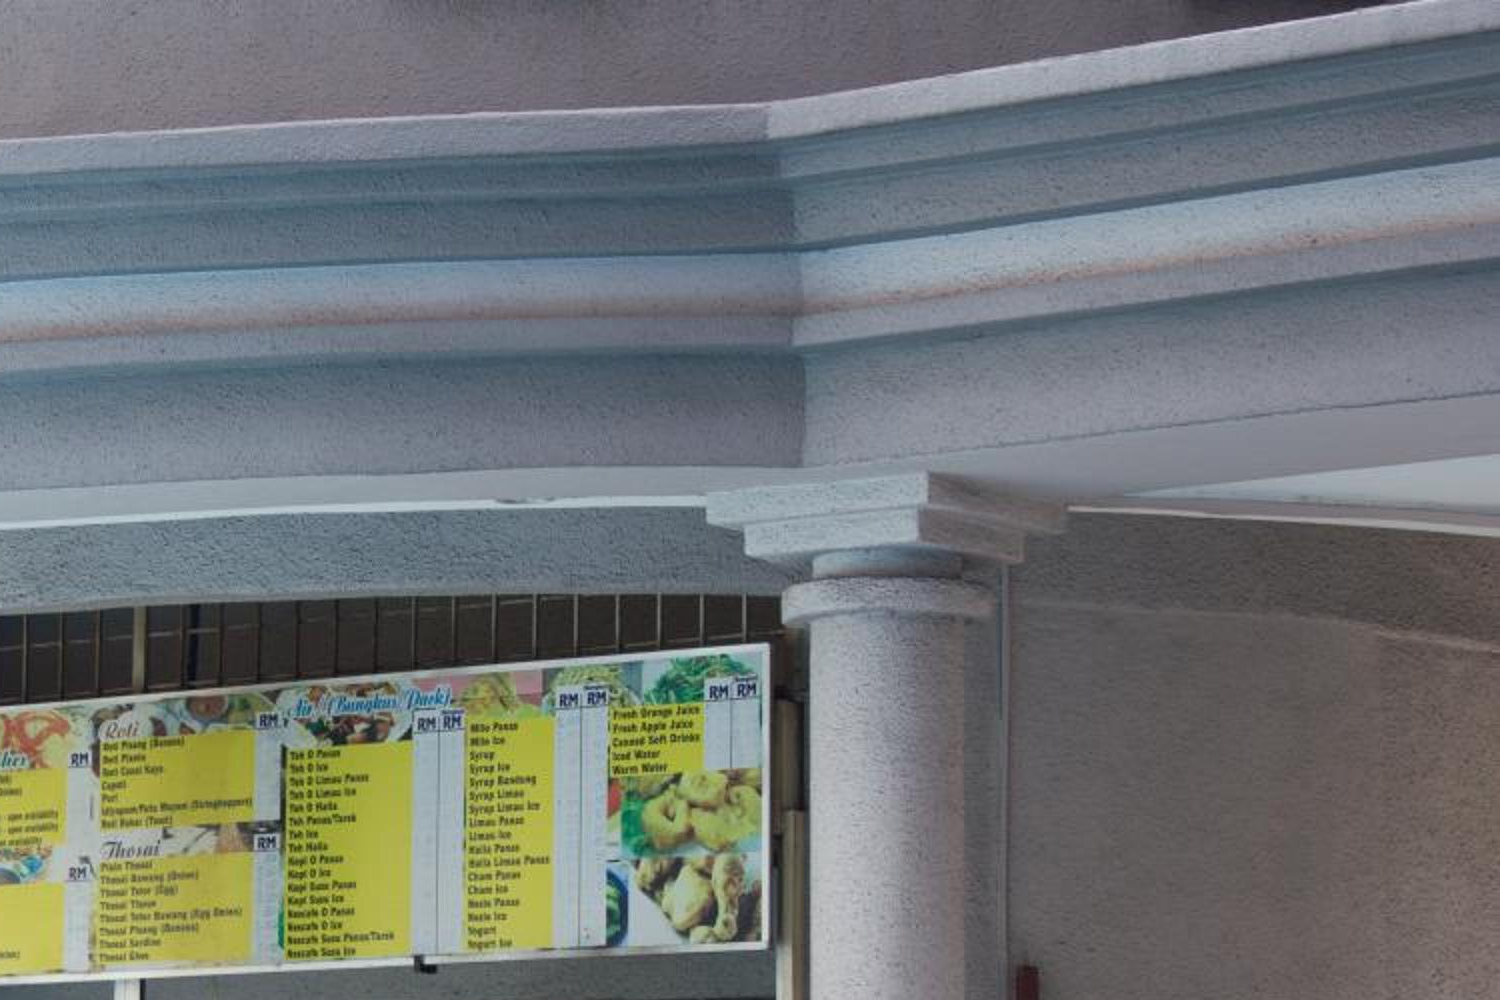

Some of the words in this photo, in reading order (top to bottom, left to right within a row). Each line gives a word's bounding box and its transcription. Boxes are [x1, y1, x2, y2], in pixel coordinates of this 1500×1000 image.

[710, 685, 728, 698] RM
[738, 682, 756, 696] RM
[560, 693, 578, 706] RM
[587, 691, 606, 704] RM
[613, 709, 637, 719] Fresh
[640, 707, 672, 718] Orange
[676, 705, 700, 715] Juice
[259, 714, 278, 727] RM
[418, 717, 436, 730] RM
[443, 714, 461, 729] RM
[612, 723, 637, 733] Fresh
[640, 721, 666, 732] Apple
[670, 719, 693, 729] Juice
[71, 752, 88, 766] RM
[102, 839, 161, 859] Thosai
[257, 837, 276, 849] RM
[69, 867, 86, 880] RM
